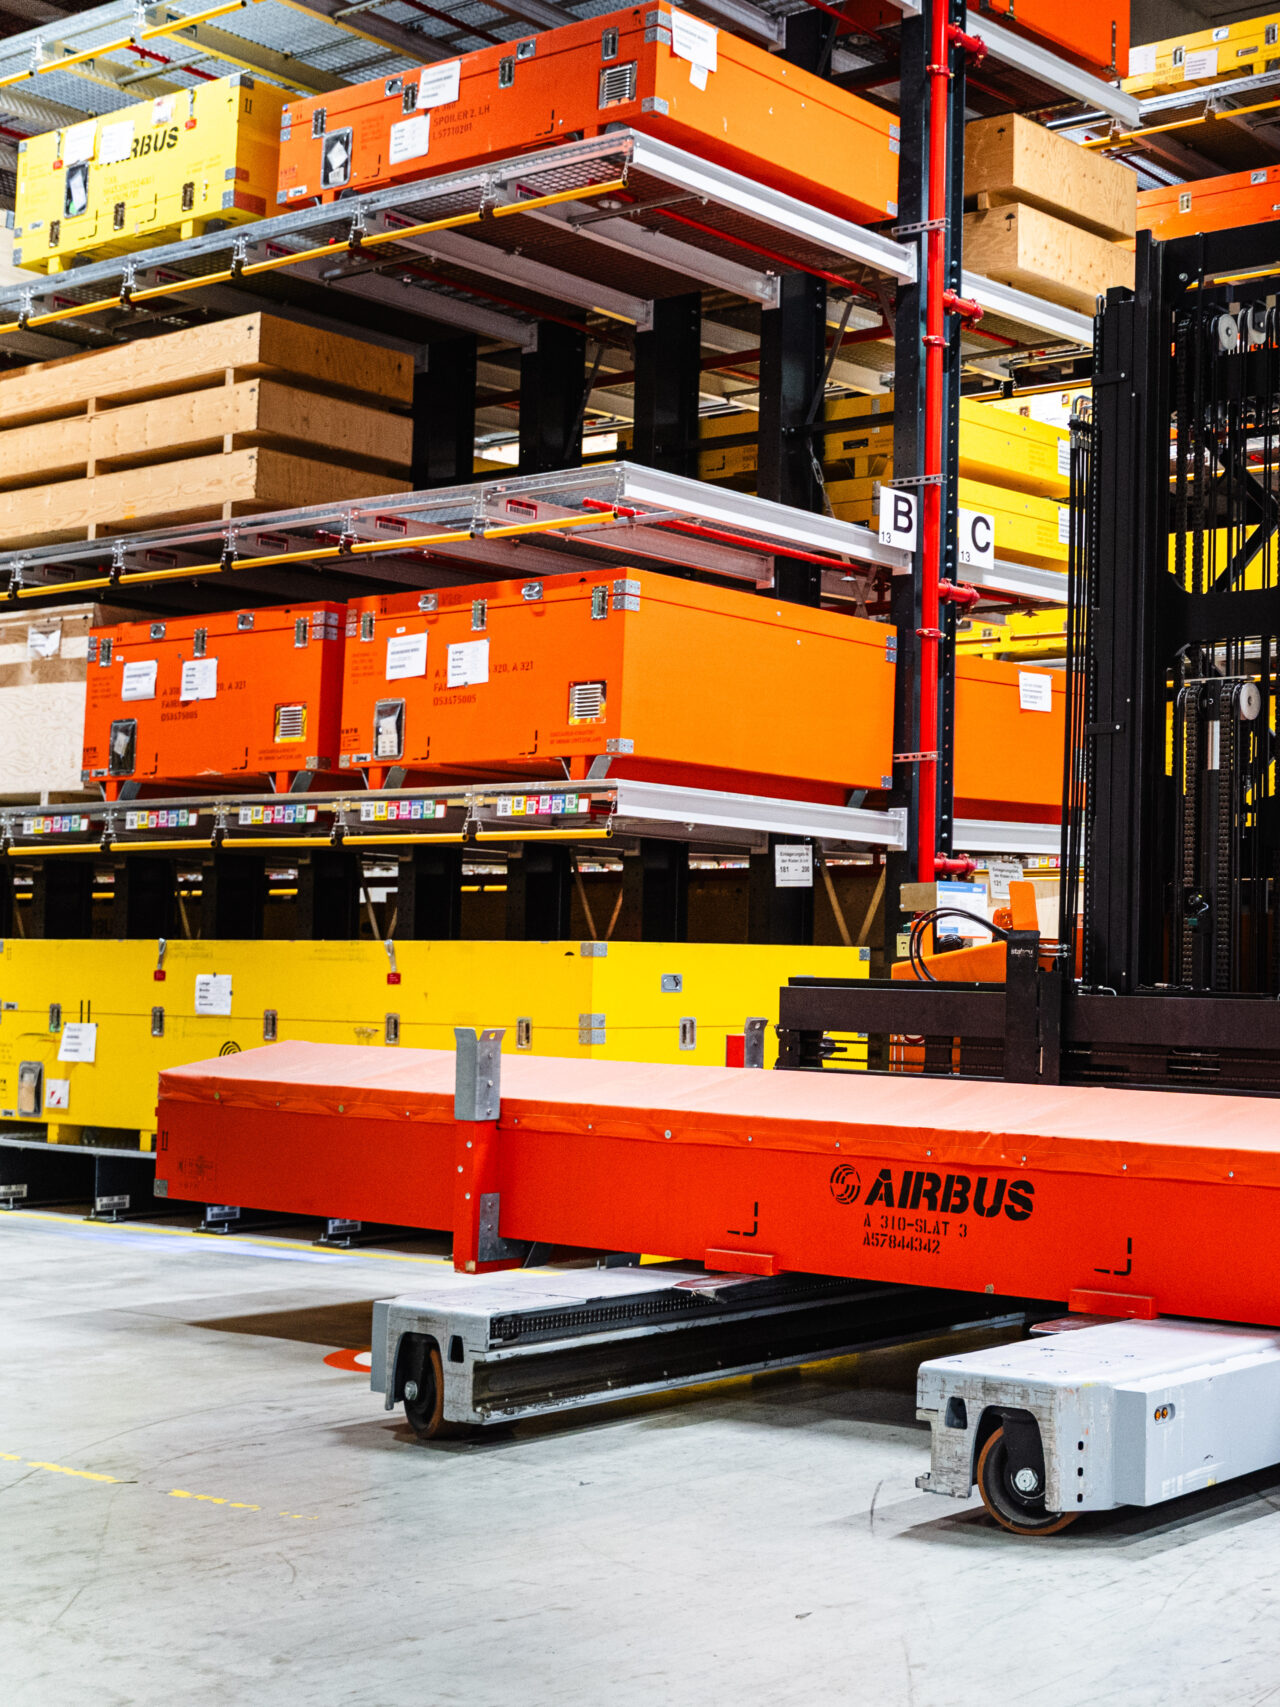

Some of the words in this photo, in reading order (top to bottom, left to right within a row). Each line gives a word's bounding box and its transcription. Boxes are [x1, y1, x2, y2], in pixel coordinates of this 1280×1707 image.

[433, 110, 468, 127] SPOILER
[893, 494, 913, 534] B
[881, 531, 892, 544] 13
[971, 515, 991, 553] C
[960, 550, 971, 562] 13
[520, 660, 534, 671] 321
[864, 1168, 1036, 1221] AIRBUS
[863, 1213, 872, 1228] A
[880, 1214, 950, 1237] 310-SLAT
[959, 1223, 968, 1238] 3
[862, 1231, 941, 1255] A57844342
